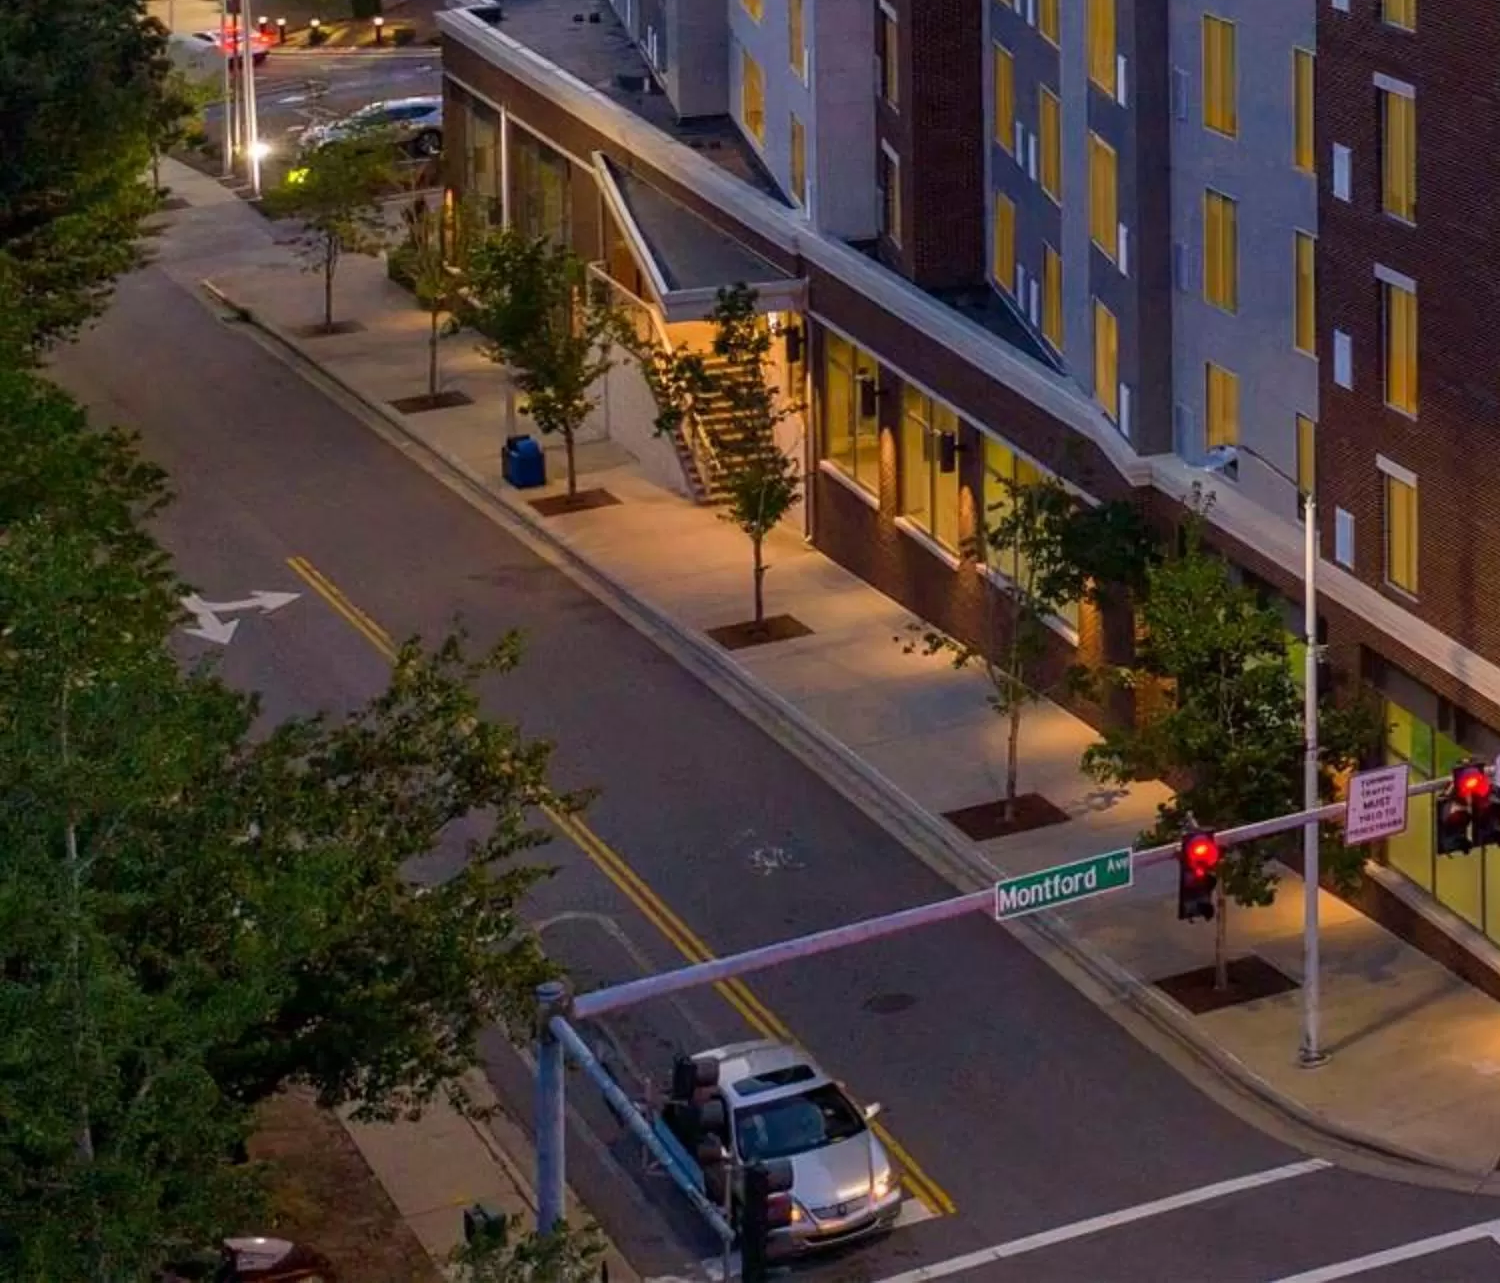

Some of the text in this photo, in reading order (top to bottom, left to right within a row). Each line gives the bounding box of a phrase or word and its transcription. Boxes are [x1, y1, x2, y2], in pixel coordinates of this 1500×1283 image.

[1363, 796, 1391, 809] MUST
[1385, 807, 1397, 817] TO
[1000, 866, 1097, 912] Montford
